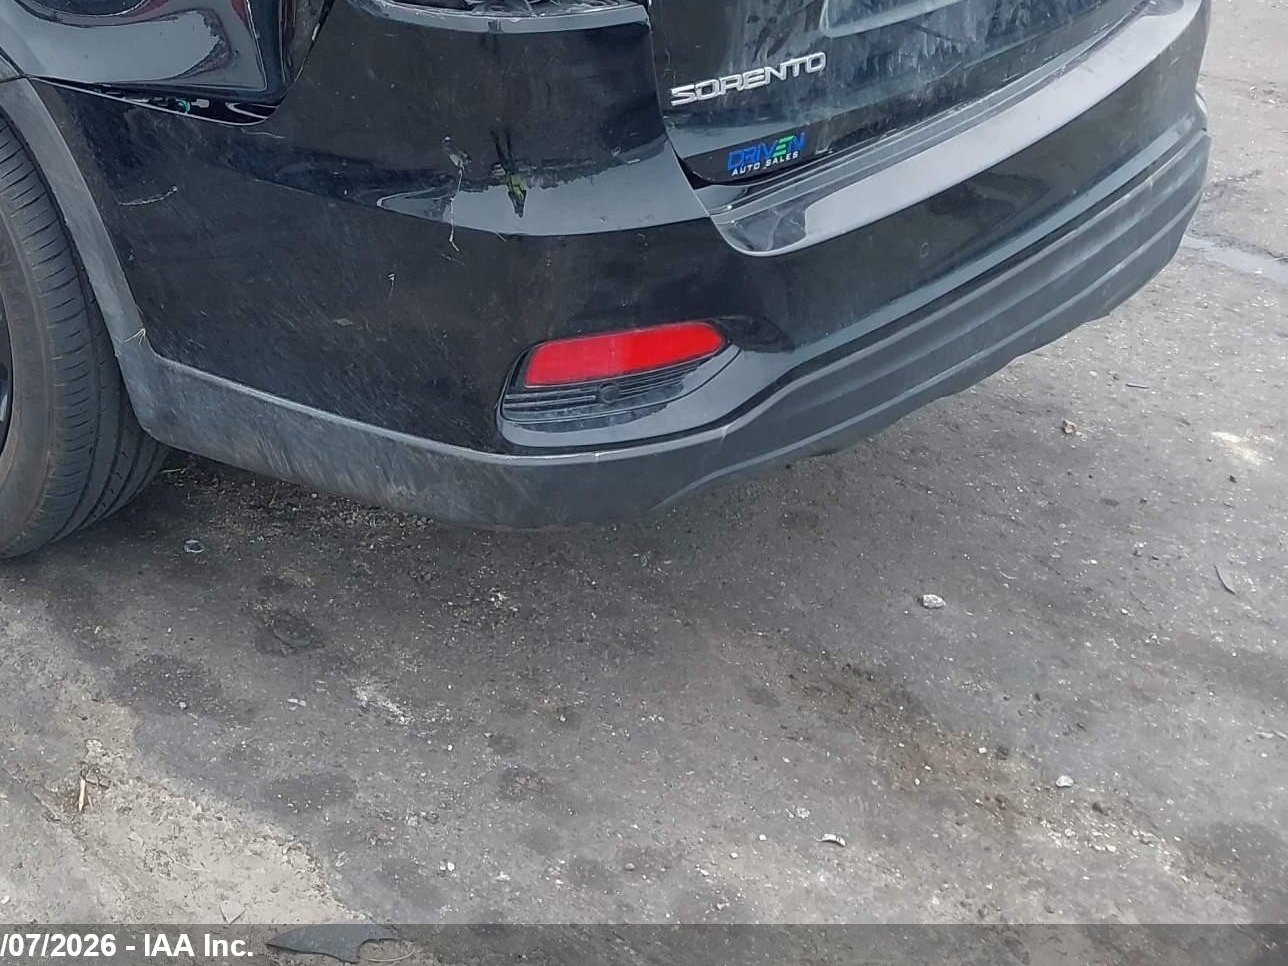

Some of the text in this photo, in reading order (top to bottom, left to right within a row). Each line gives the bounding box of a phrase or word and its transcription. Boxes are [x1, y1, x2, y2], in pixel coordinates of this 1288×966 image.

[670, 51, 826, 106] SORENTO
[727, 132, 805, 170] DRIVEN
[731, 150, 799, 177] AUTO SALES
